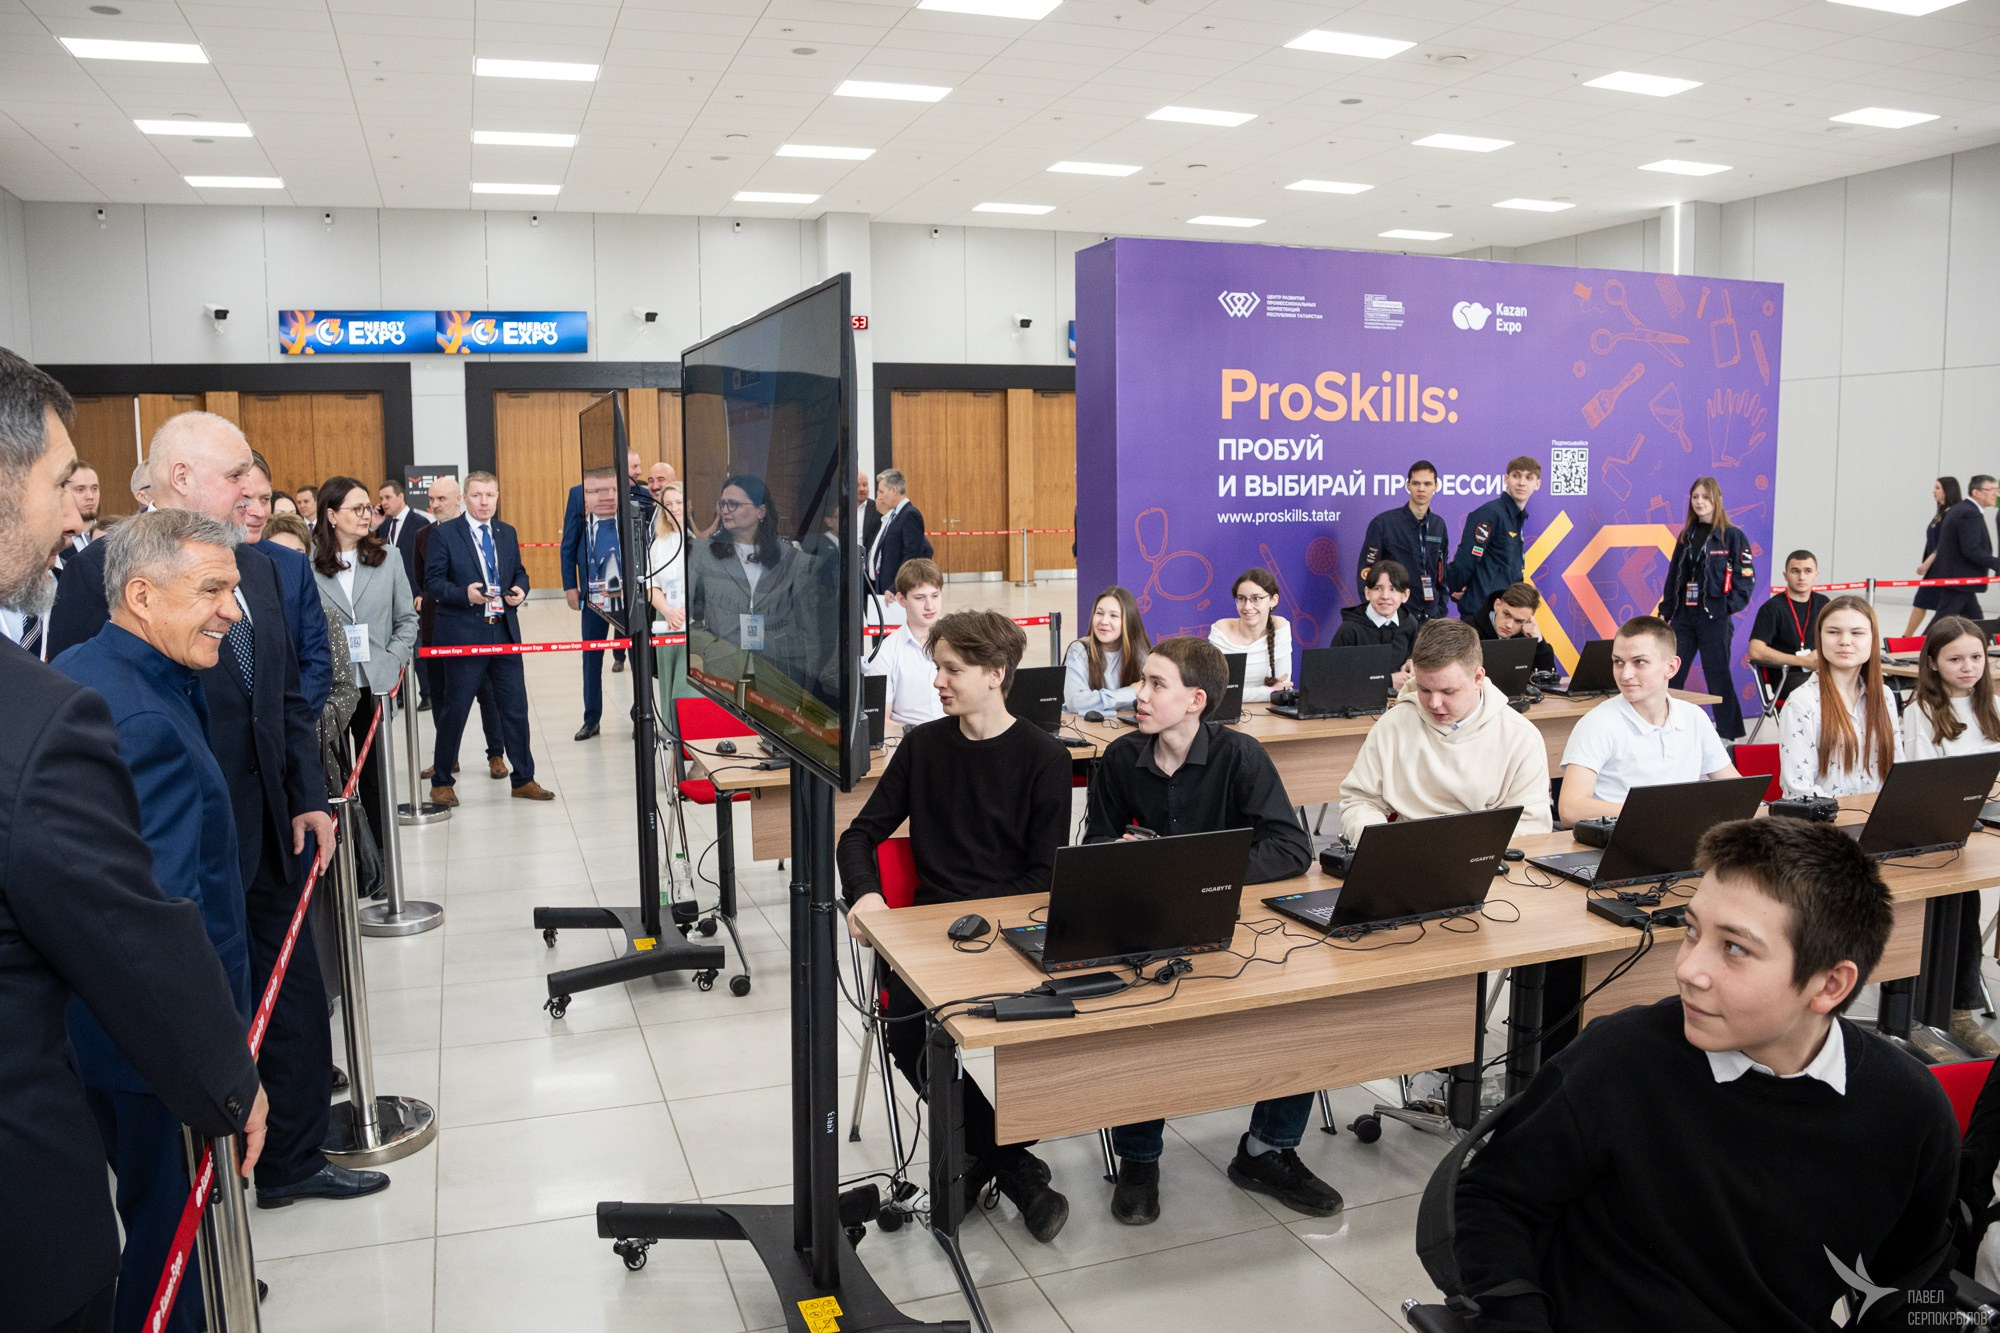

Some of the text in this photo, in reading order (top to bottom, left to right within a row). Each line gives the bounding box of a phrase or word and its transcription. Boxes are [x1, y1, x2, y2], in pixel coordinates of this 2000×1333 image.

[1496, 302, 1527, 317] Kazan
[1496, 318, 1522, 335] Expo
[348, 328, 406, 345] EXPO
[503, 328, 558, 345] EXPO
[1221, 368, 1459, 424] ProSkills:
[1219, 433, 1324, 461] ПРОБУЙ
[1219, 475, 1236, 497] И
[1245, 469, 1365, 497] ВЫБИРАЙ
[1217, 508, 1341, 526] www.proskills.tatar
[1470, 854, 1496, 863] GIGABYTE
[1201, 884, 1232, 893] GIGABYTE
